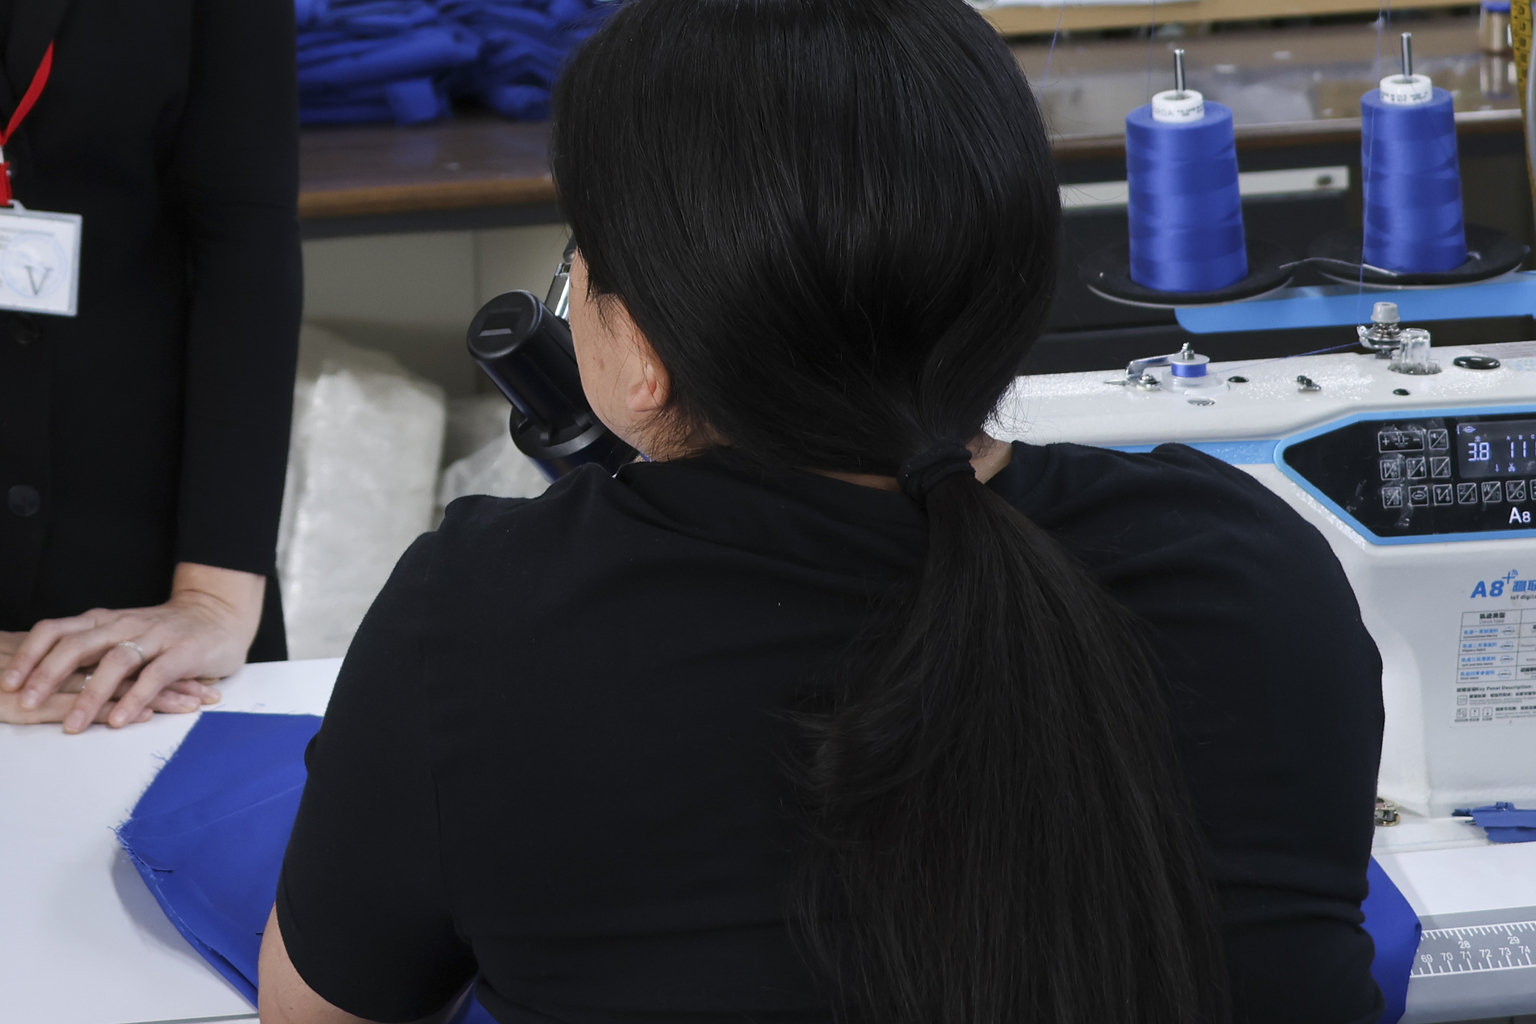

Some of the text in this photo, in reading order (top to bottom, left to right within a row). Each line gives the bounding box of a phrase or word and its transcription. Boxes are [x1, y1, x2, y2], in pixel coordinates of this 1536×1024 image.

[24, 265, 53, 296] V
[1468, 442, 1490, 461] 3.8
[1509, 506, 1531, 524] A8
[1458, 936, 1520, 949] 28 29
[1420, 945, 1531, 963] 69 70 71 72 73 74
